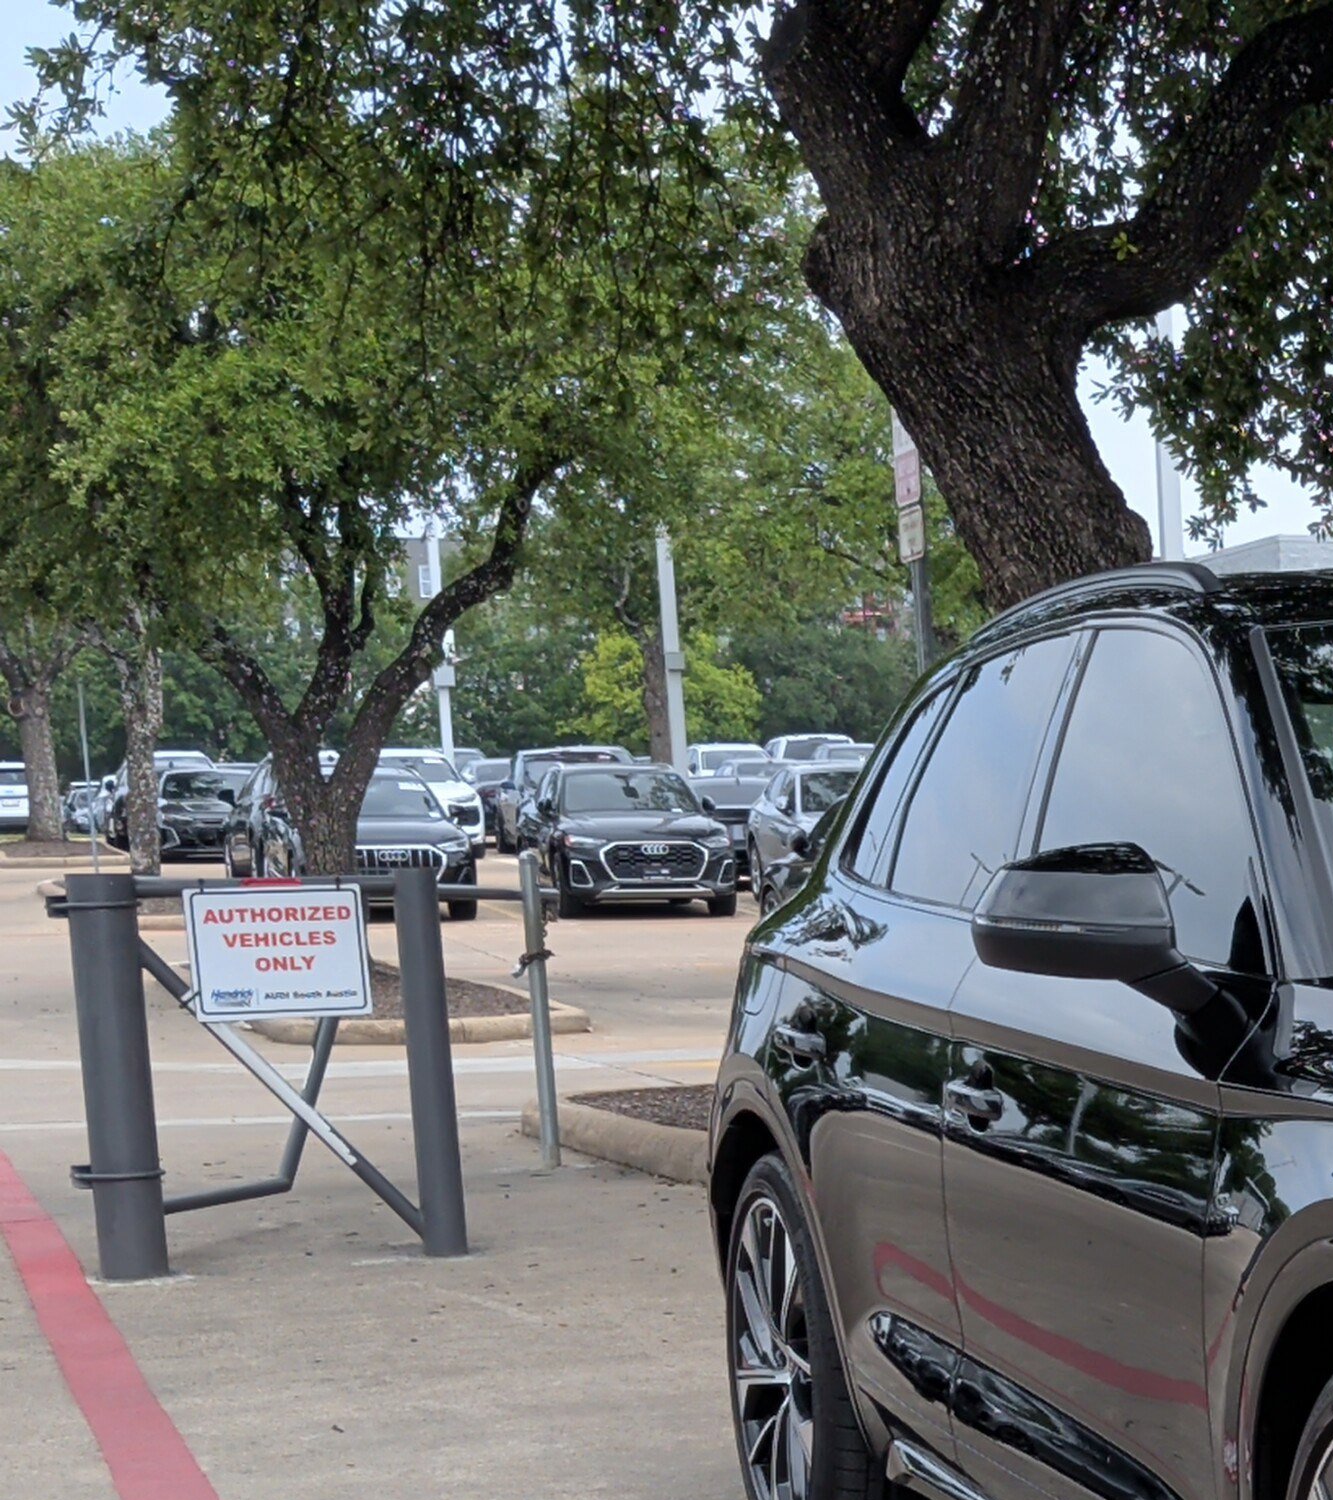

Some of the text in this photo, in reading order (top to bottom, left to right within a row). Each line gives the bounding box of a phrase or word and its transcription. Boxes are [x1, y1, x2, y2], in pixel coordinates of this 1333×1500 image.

[203, 905, 351, 925] AUTHORIZED
[222, 931, 337, 948] VEHICLES
[255, 955, 316, 972] ONLY
